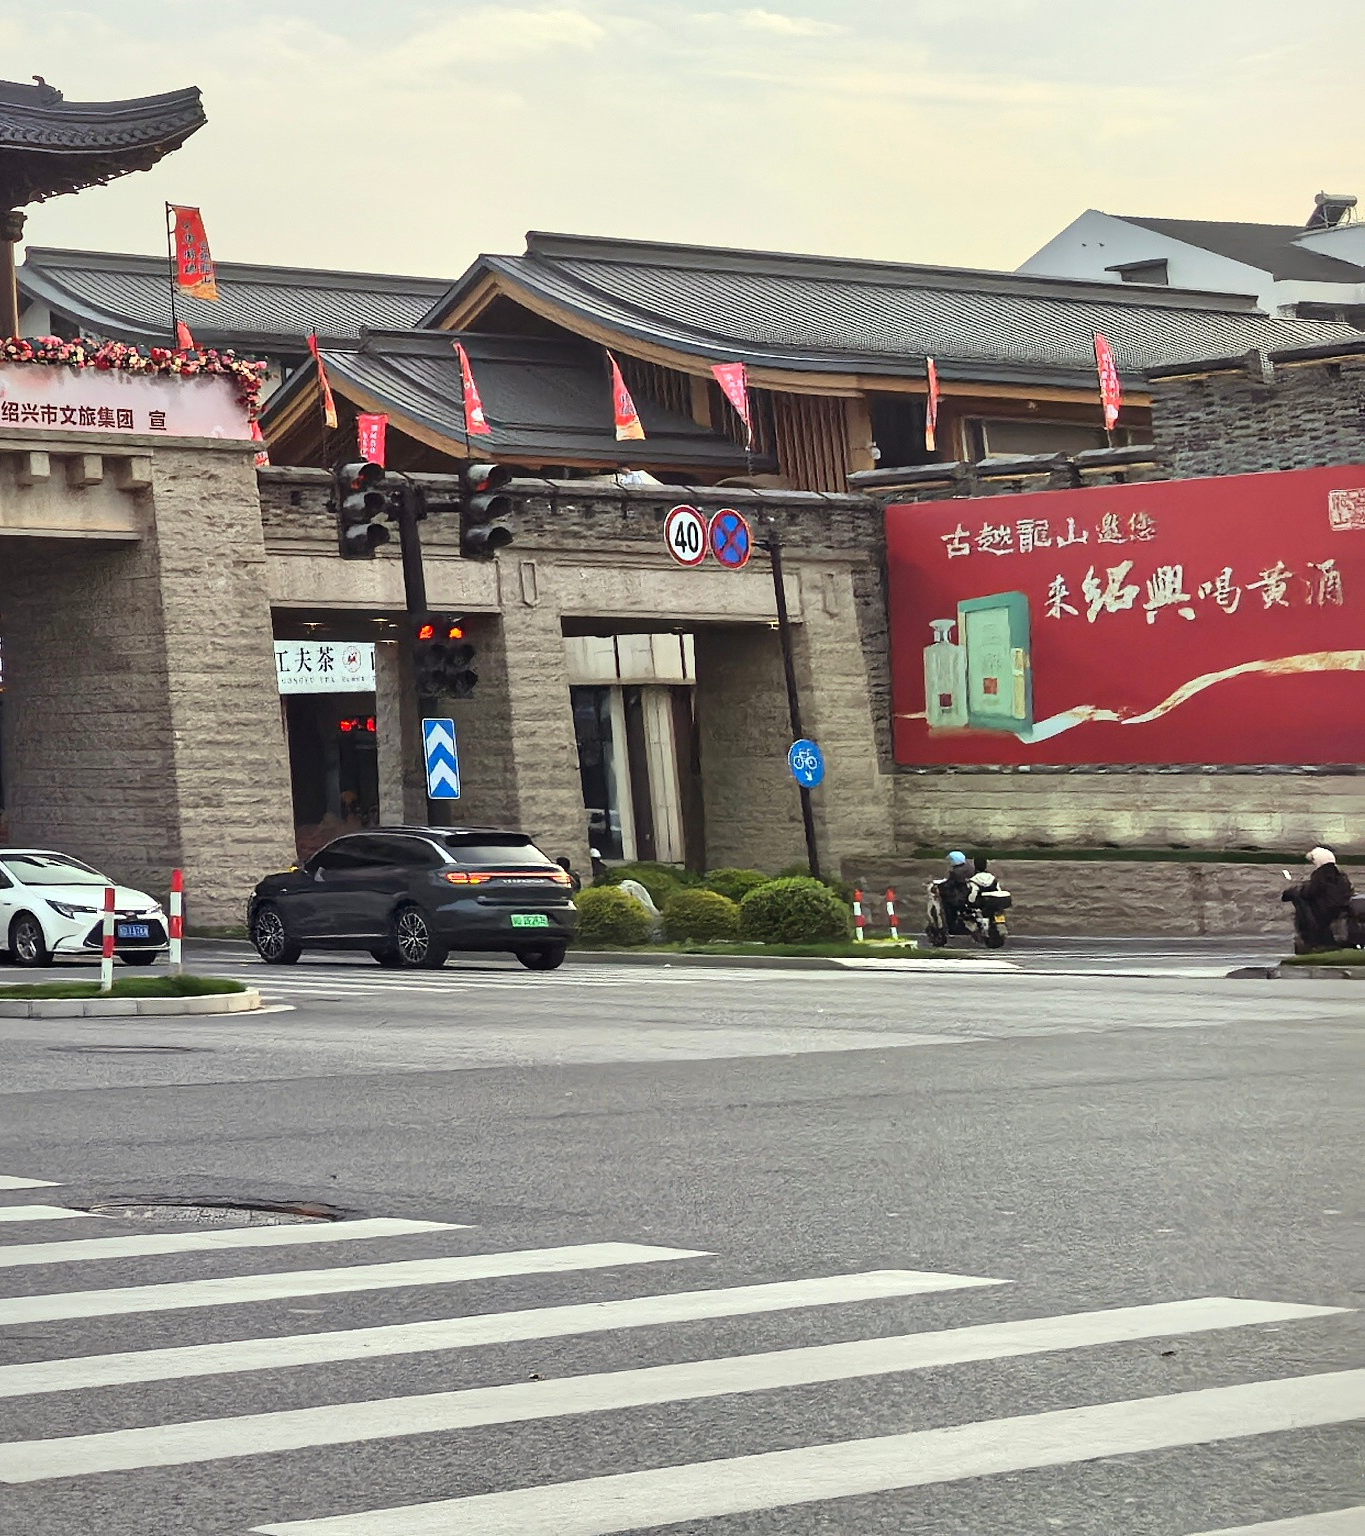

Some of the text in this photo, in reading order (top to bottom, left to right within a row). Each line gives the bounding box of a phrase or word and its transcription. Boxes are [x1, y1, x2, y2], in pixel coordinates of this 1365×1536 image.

[0, 400, 167, 431] 绍兴市文旅集团 宣
[674, 520, 699, 554] 40
